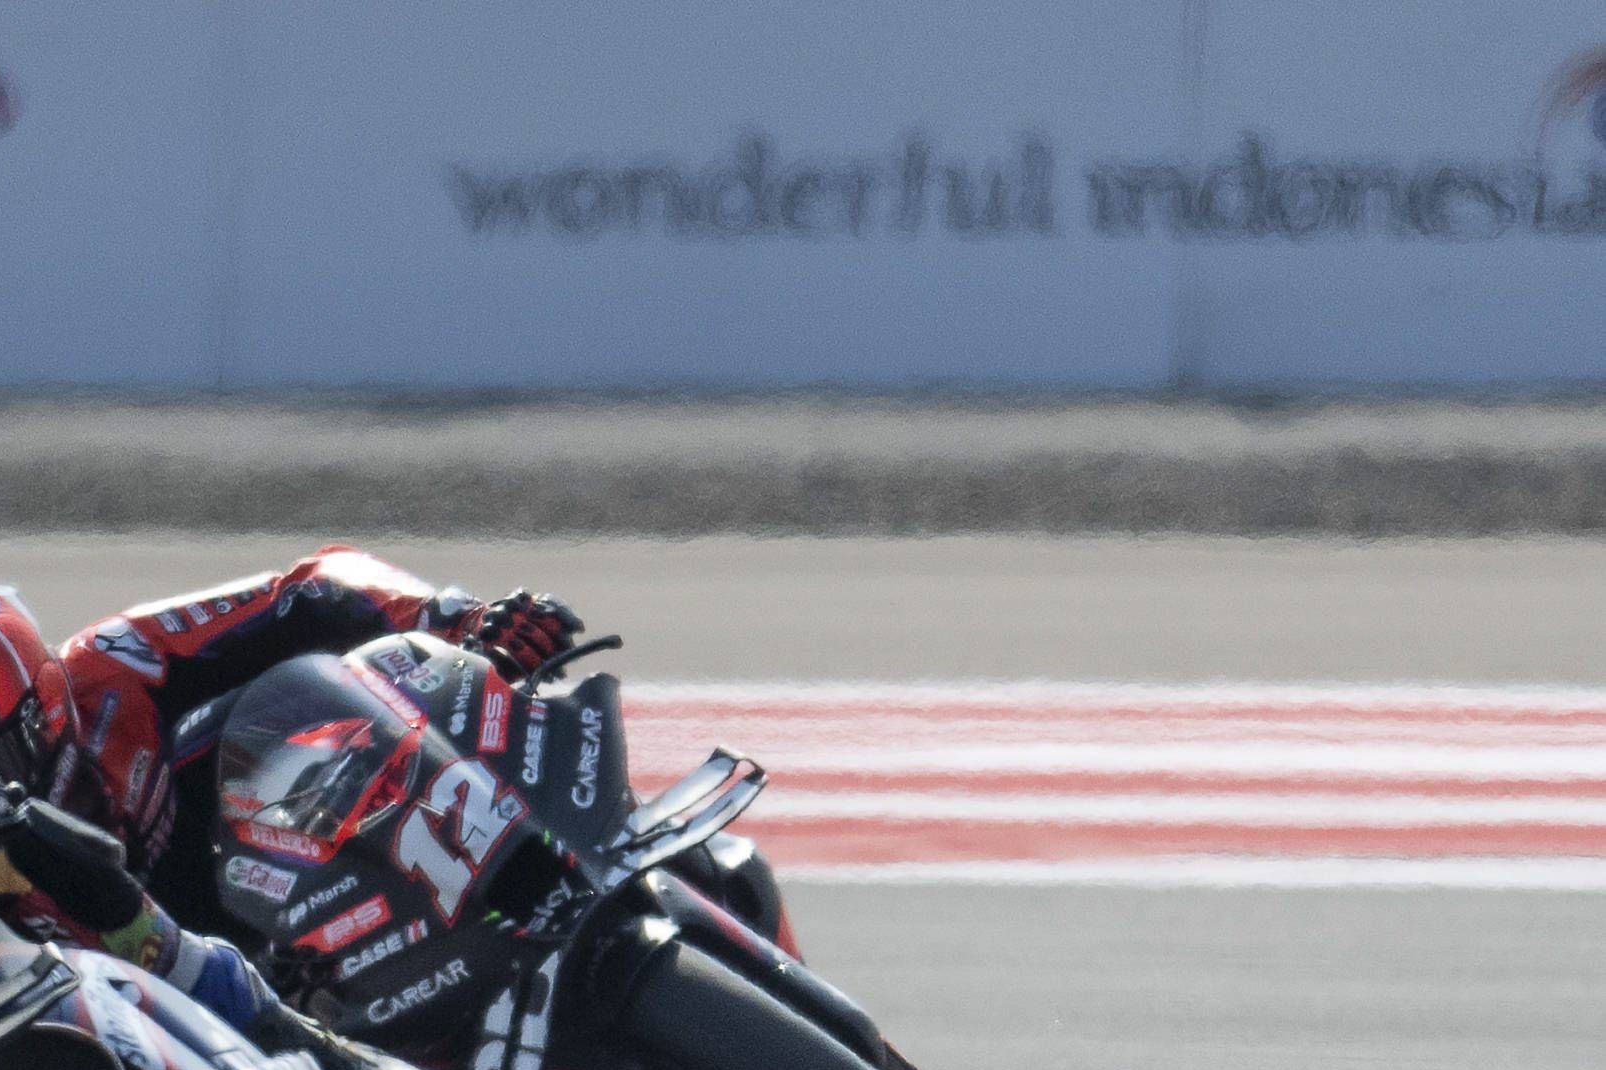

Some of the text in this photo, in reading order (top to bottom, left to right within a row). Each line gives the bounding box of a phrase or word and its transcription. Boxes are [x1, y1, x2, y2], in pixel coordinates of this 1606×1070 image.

[456, 667, 475, 710] Marsh
[480, 691, 505, 748] BS
[522, 724, 543, 784] CASE
[571, 706, 603, 809] CAREAR
[395, 757, 528, 924] 12
[307, 875, 360, 910] Marsh
[341, 931, 405, 980] CASE
[366, 957, 473, 1024] CAREAR
